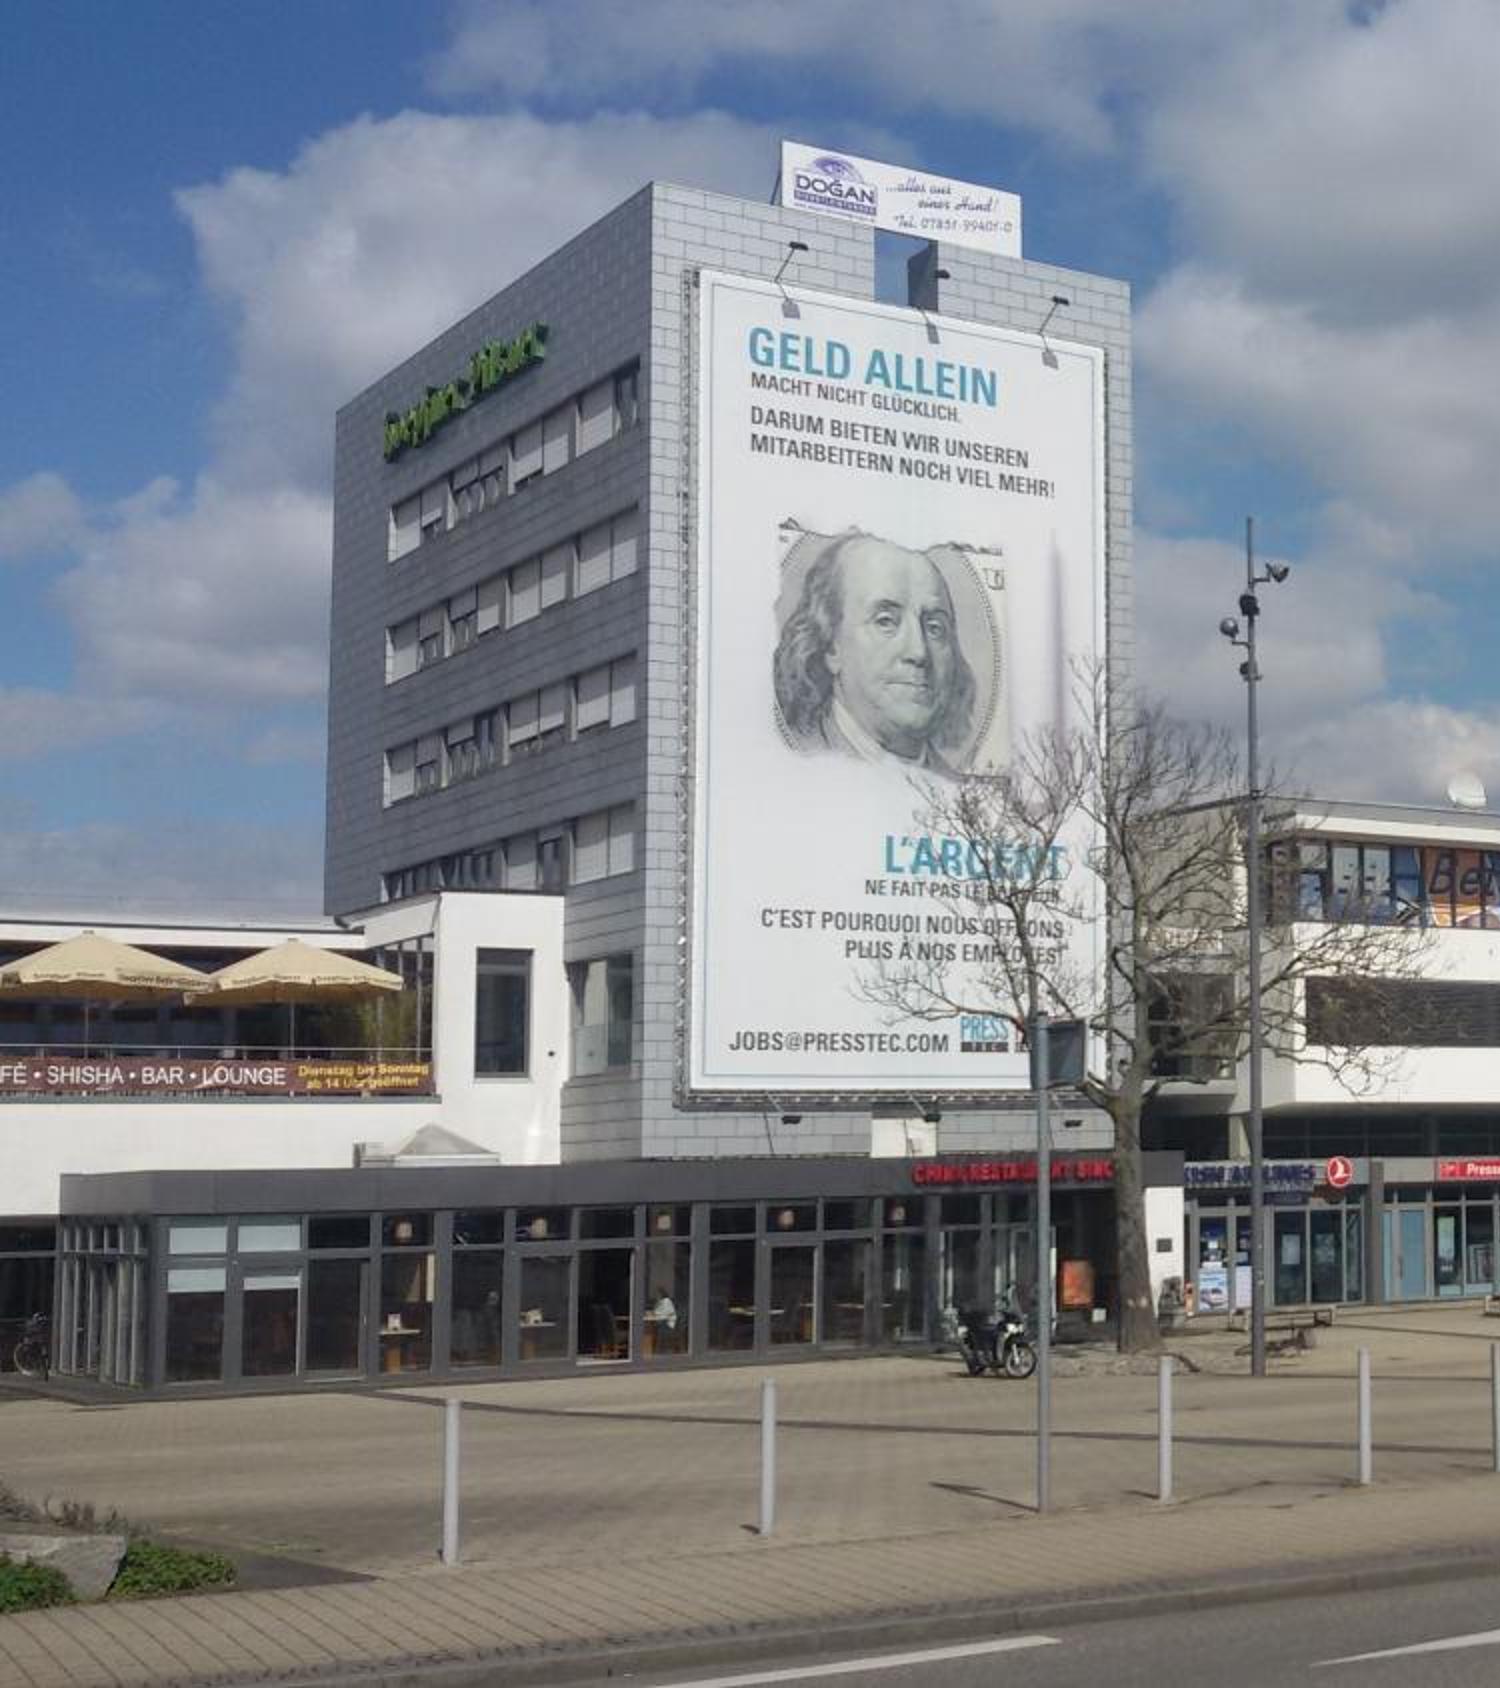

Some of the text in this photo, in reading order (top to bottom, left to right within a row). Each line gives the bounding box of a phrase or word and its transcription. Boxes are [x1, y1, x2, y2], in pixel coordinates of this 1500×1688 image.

[748, 327, 997, 407] GELD ALLEIN
[751, 371, 813, 398] MACHT
[817, 384, 867, 408] NICHT
[751, 405, 1030, 469] DARUM BIETEN WIR UNSEREN
[750, 434, 1056, 499] MITARBEITERN NOCH VIEL MEHR!
[865, 879, 890, 897] NE
[891, 881, 927, 899] FAIT
[929, 883, 962, 900] PAS
[761, 908, 1063, 940] C'EST POURQUOI NOUS OFFONS
[845, 939, 893, 961] PLUS
[917, 941, 957, 962] NOS
[729, 1031, 950, 1053] JOBS@PRESSTEC.COM
[961, 1015, 1009, 1041] PRESS
[47, 1065, 125, 1085] SHISHA
[141, 1067, 185, 1085] BAR
[202, 1065, 286, 1085] LOUNGE
